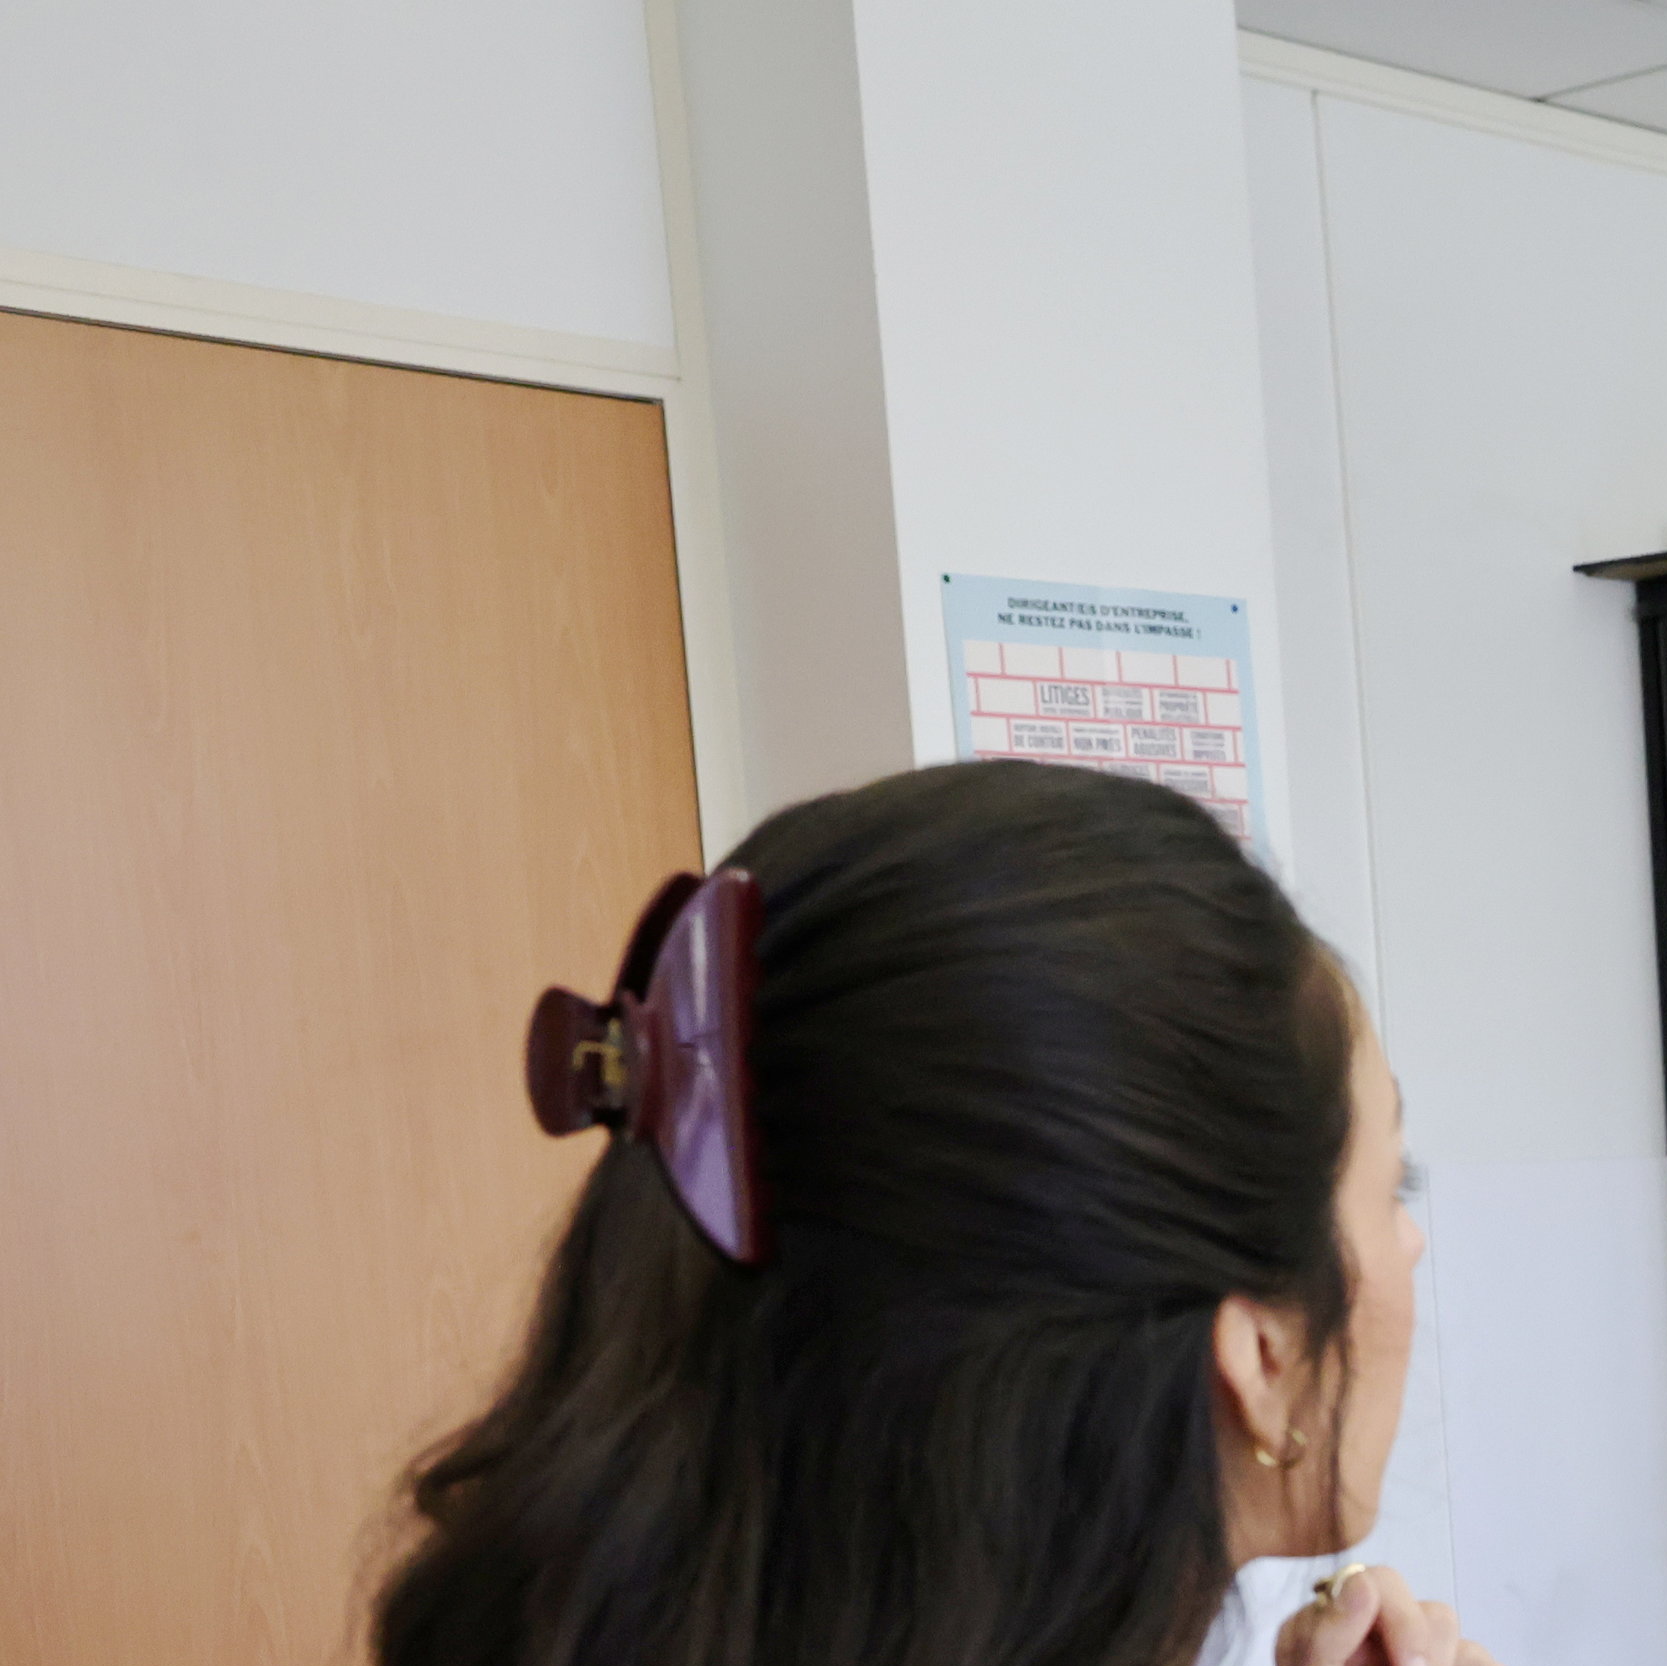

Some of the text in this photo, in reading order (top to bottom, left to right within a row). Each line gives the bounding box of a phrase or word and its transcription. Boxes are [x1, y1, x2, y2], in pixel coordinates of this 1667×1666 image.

[998, 612, 1014, 626] NE
[1018, 613, 1066, 629] RESTEZ
[1069, 616, 1093, 631] PAS
[1096, 619, 1130, 634] DANS
[1040, 683, 1090, 706] LITIGES
